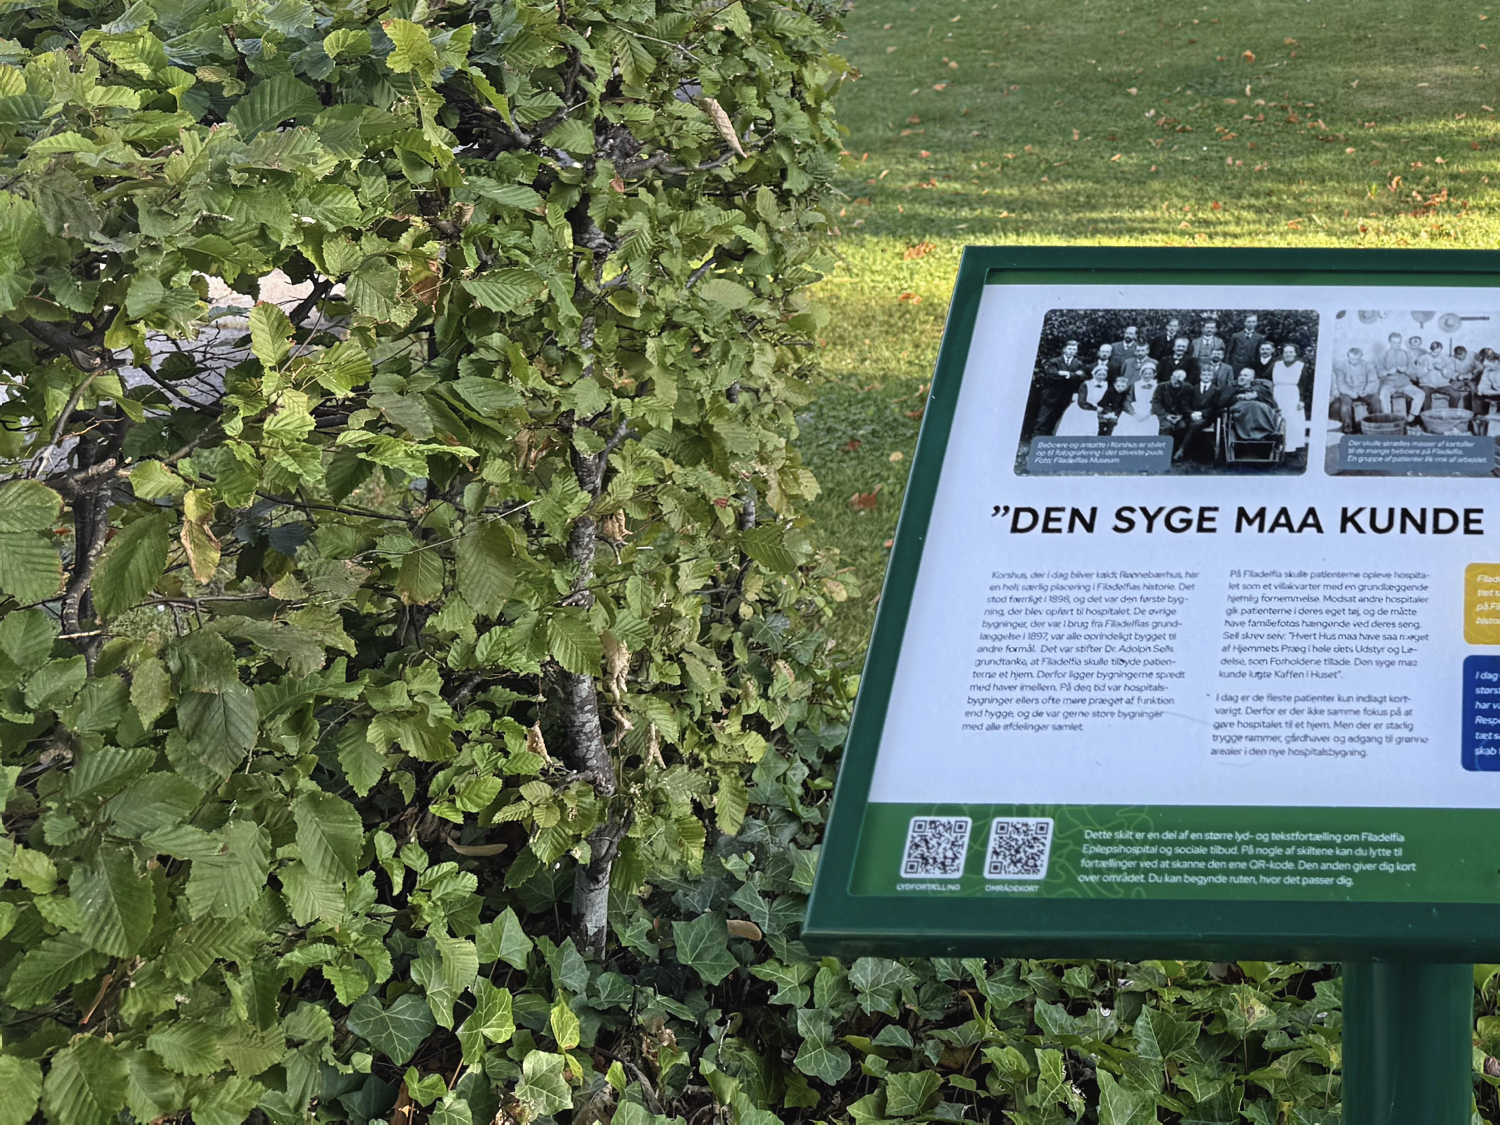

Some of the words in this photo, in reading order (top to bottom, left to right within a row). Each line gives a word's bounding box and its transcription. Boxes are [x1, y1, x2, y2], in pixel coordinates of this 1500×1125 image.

[1112, 505, 1219, 535] SYGE
[1234, 506, 1325, 535] MAA
[1339, 506, 1484, 536] KUNDE
[1479, 671, 1498, 683] dag
[1474, 701, 1489, 710] har
[1244, 706, 1275, 715] Derfor
[1288, 706, 1304, 715] der
[1306, 706, 1324, 716] ikke
[1362, 707, 1388, 716] fokus
[1389, 707, 1401, 719] på
[1403, 708, 1413, 716] at
[1474, 732, 1491, 740] tæt
[1248, 747, 1266, 756] den
[1268, 749, 1285, 759] nye
[1474, 746, 1497, 756] skab
[1084, 830, 1112, 840] Dette
[1114, 830, 1133, 840] skilt
[1161, 830, 1176, 841] del
[1178, 830, 1187, 841] af
[1189, 833, 1202, 841] en
[1204, 832, 1233, 841] større
[1234, 831, 1252, 844] lyd-
[1255, 834, 1269, 844] og
[1270, 831, 1341, 845] tekstfortælling
[1343, 834, 1359, 842] om
[1360, 832, 1404, 842] Filadelfia
[1082, 844, 1157, 858] Epilepsihospital
[1158, 847, 1172, 858] og
[1174, 845, 1207, 855] sociale
[1240, 845, 1254, 855] På
[1255, 845, 1283, 858] nogle
[1284, 845, 1294, 856] af
[1296, 845, 1333, 856] skiltene
[1335, 846, 1352, 856] kan
[1353, 846, 1367, 856] du
[1369, 846, 1391, 859] lytte
[1393, 846, 1403, 856] til
[1080, 858, 1136, 871] fortællinger
[1139, 858, 1157, 869] ved
[1159, 860, 1169, 869] at
[1170, 859, 1205, 869] skanne
[1207, 859, 1226, 869] den
[1228, 862, 1247, 870] ene
[1297, 860, 1318, 870] Den
[1320, 860, 1350, 871] anden
[1352, 860, 1376, 873] giver
[1378, 861, 1394, 874] dig
[1396, 861, 1416, 871] kort
[1078, 875, 1099, 883] over
[1147, 873, 1162, 883] Du
[1164, 873, 1181, 883] kan
[1183, 873, 1227, 887] begynde
[1229, 875, 1257, 885] ruten,
[1259, 874, 1280, 884] hvor
[1282, 874, 1299, 885] det
[1301, 877, 1333, 888] passer
[1335, 875, 1354, 888] dig.
[985, 883, 1040, 893] OMRÅDEKORT
